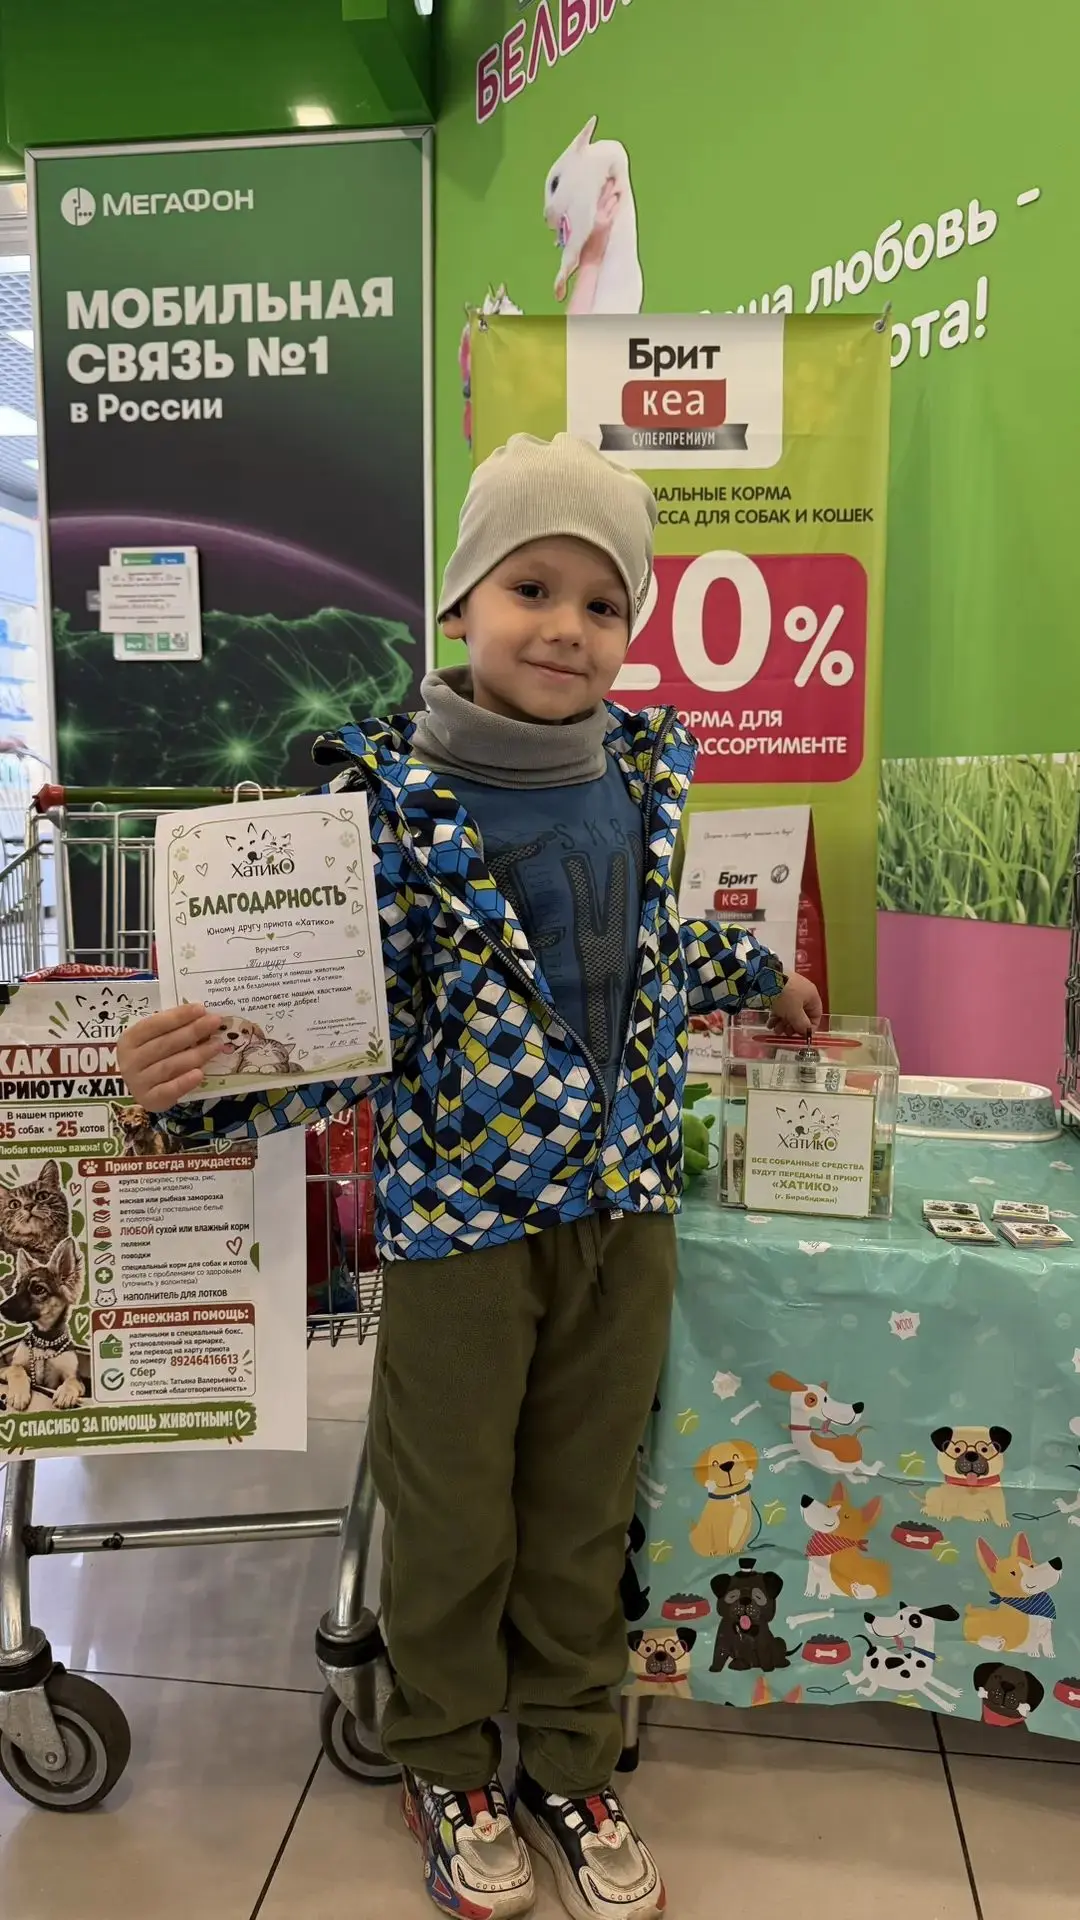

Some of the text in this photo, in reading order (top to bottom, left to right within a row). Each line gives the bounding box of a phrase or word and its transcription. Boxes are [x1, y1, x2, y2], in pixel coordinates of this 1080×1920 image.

[804, 198, 998, 313] любовь
[66, 276, 394, 330] МОБИЛЬНАЯ
[890, 275, 989, 369] ота!
[66, 335, 329, 384] СВЯЗЬ №1
[629, 338, 721, 377] Брит
[69, 393, 223, 424] в России
[643, 389, 705, 416] кеа
[632, 431, 716, 447] СУПЕРПРЕМИУМ
[731, 486, 792, 501] КОРМА
[657, 508, 874, 527] ССА ДЛЯ СОБАК И КОШЕК
[676, 710, 783, 731] ОРМА ДЛЯ
[718, 871, 758, 888] Брит
[188, 885, 347, 918] БЛАГОДАРНОСТЬ
[722, 892, 749, 906] кеа
[206, 917, 335, 936] Юному другу приюта «Хатико»
[255, 945, 290, 954] Вручается
[213, 975, 236, 985] доброе
[262, 971, 283, 981] заботу
[289, 968, 313, 978] помощь
[314, 965, 345, 974] животным
[207, 985, 231, 994] приюта
[232, 984, 245, 993] для
[246, 979, 280, 991] бездомных
[281, 977, 311, 986] животных
[203, 985, 353, 1009] Спасибо, что помогаете нашим хвостикам
[247, 996, 321, 1013] делаете мир добрее!
[77, 1020, 127, 1039] Хати
[60, 1047, 120, 1074] ПОМ
[0, 1078, 129, 1100] РИЮТУ «ХАТ
[7, 1110, 84, 1119] В нашем приюте
[18, 1125, 44, 1134] собак
[56, 1121, 78, 1138] 25
[80, 1125, 105, 1133] котов
[30, 1144, 67, 1154] помощь
[69, 1142, 101, 1152] важна!
[105, 1157, 252, 1173] Приют всегда нуждается:
[768, 1158, 820, 1167] СОБРАННЫЕ
[821, 1162, 865, 1171] СРЕДСТВА
[118, 1178, 139, 1186] крупа
[751, 1168, 777, 1176] БУДУТ
[778, 1171, 824, 1180] ПЕРЕДАНЫ
[833, 1174, 864, 1183] ПРИЮТ
[772, 1179, 839, 1192] «ХАТИКО»
[119, 1197, 145, 1205] мясная
[159, 1195, 187, 1204] рыбная
[187, 1193, 224, 1202] заморозка
[162, 1204, 203, 1213] постельное
[203, 1203, 224, 1211] белье
[119, 1222, 250, 1236] ЛЮБОЙ сухой или влажный корм
[120, 1240, 151, 1248] пеленки
[120, 1252, 151, 1260] поводки
[121, 1262, 168, 1271] специальный
[168, 1262, 187, 1270] корм
[188, 1261, 201, 1269] для
[202, 1260, 221, 1268] собак
[153, 1269, 195, 1279] проблемами
[206, 1267, 242, 1276] здоровьем
[123, 1288, 228, 1301] наполнитель для лотков
[122, 1308, 250, 1326] Денежная помощь:
[129, 1331, 170, 1339] наличными
[176, 1328, 223, 1338] специальный
[129, 1338, 183, 1348] установленный
[144, 1348, 173, 1357] перевод
[184, 1346, 203, 1355] карту
[204, 1346, 230, 1354] приюта
[140, 1356, 167, 1365] номеру
[170, 1354, 239, 1367] 89246416613
[129, 1367, 156, 1378] Сбер
[170, 1378, 196, 1386] Татьяна
[197, 1377, 237, 1386] Валерьевна
[135, 1385, 247, 1396] пометкой «благотворительность»
[18, 1410, 233, 1437] СПАСИБО ЗА ПОМОЩЬ ЖИВОТНЫМ!
[476, 1882, 503, 1891] COOL
[611, 1893, 639, 1901] COOL
